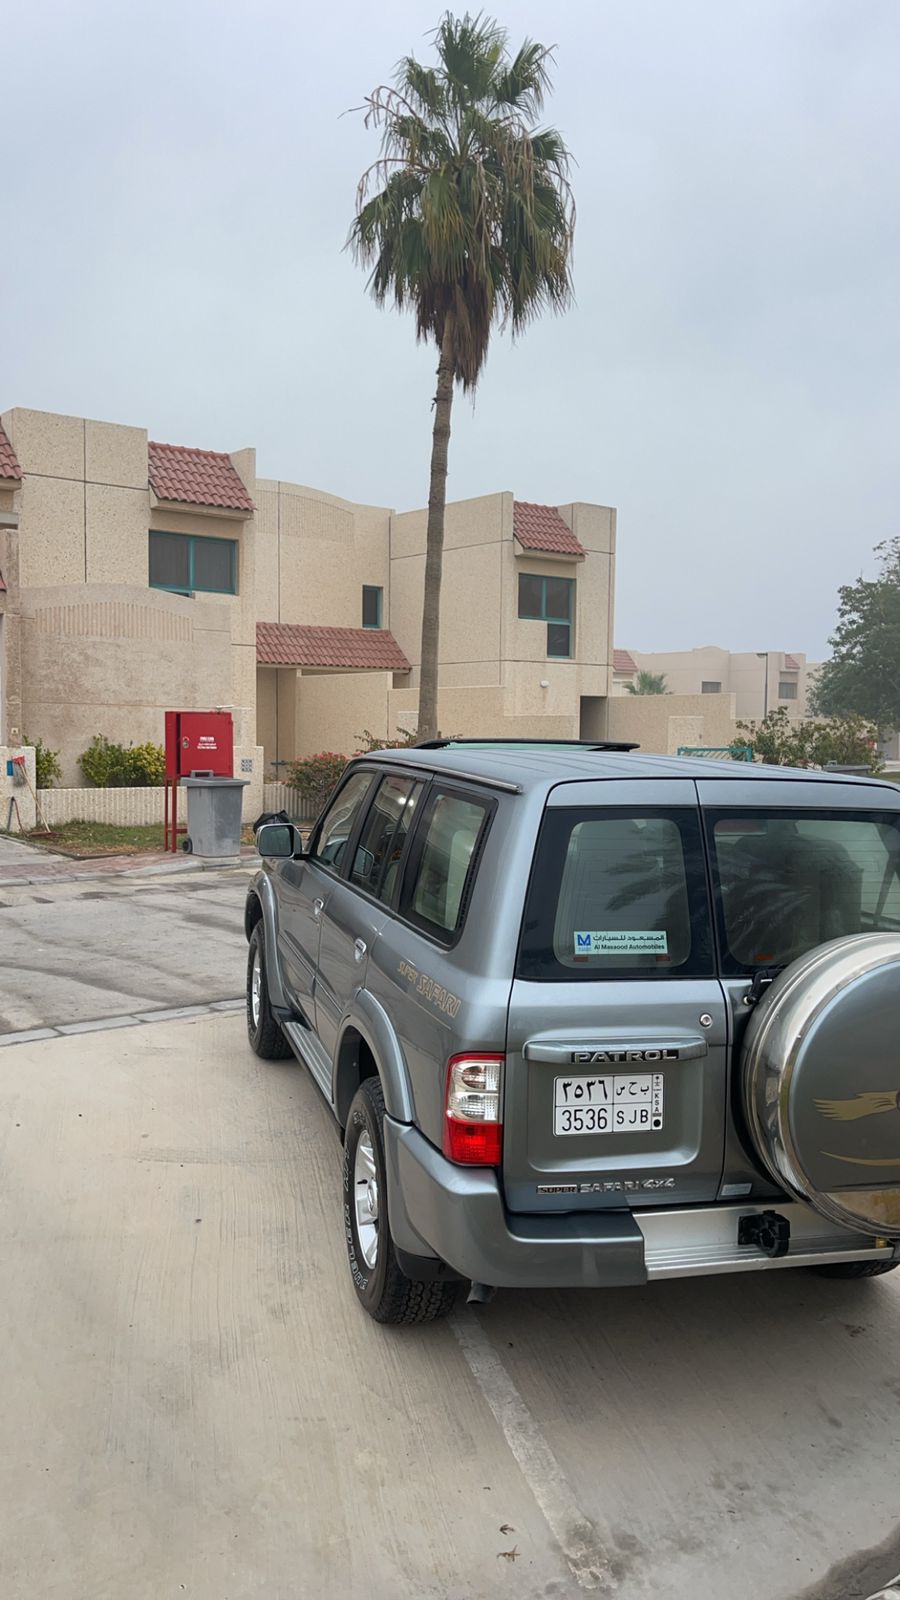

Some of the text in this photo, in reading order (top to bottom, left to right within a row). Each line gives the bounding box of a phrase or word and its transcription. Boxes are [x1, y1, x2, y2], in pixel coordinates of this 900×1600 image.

[416, 974, 461, 1018] SAFARI
[574, 1049, 677, 1063] PATROL
[562, 1108, 608, 1131] 3536
[540, 1185, 577, 1193] SUPER
[580, 1181, 640, 1193] SAFARI
